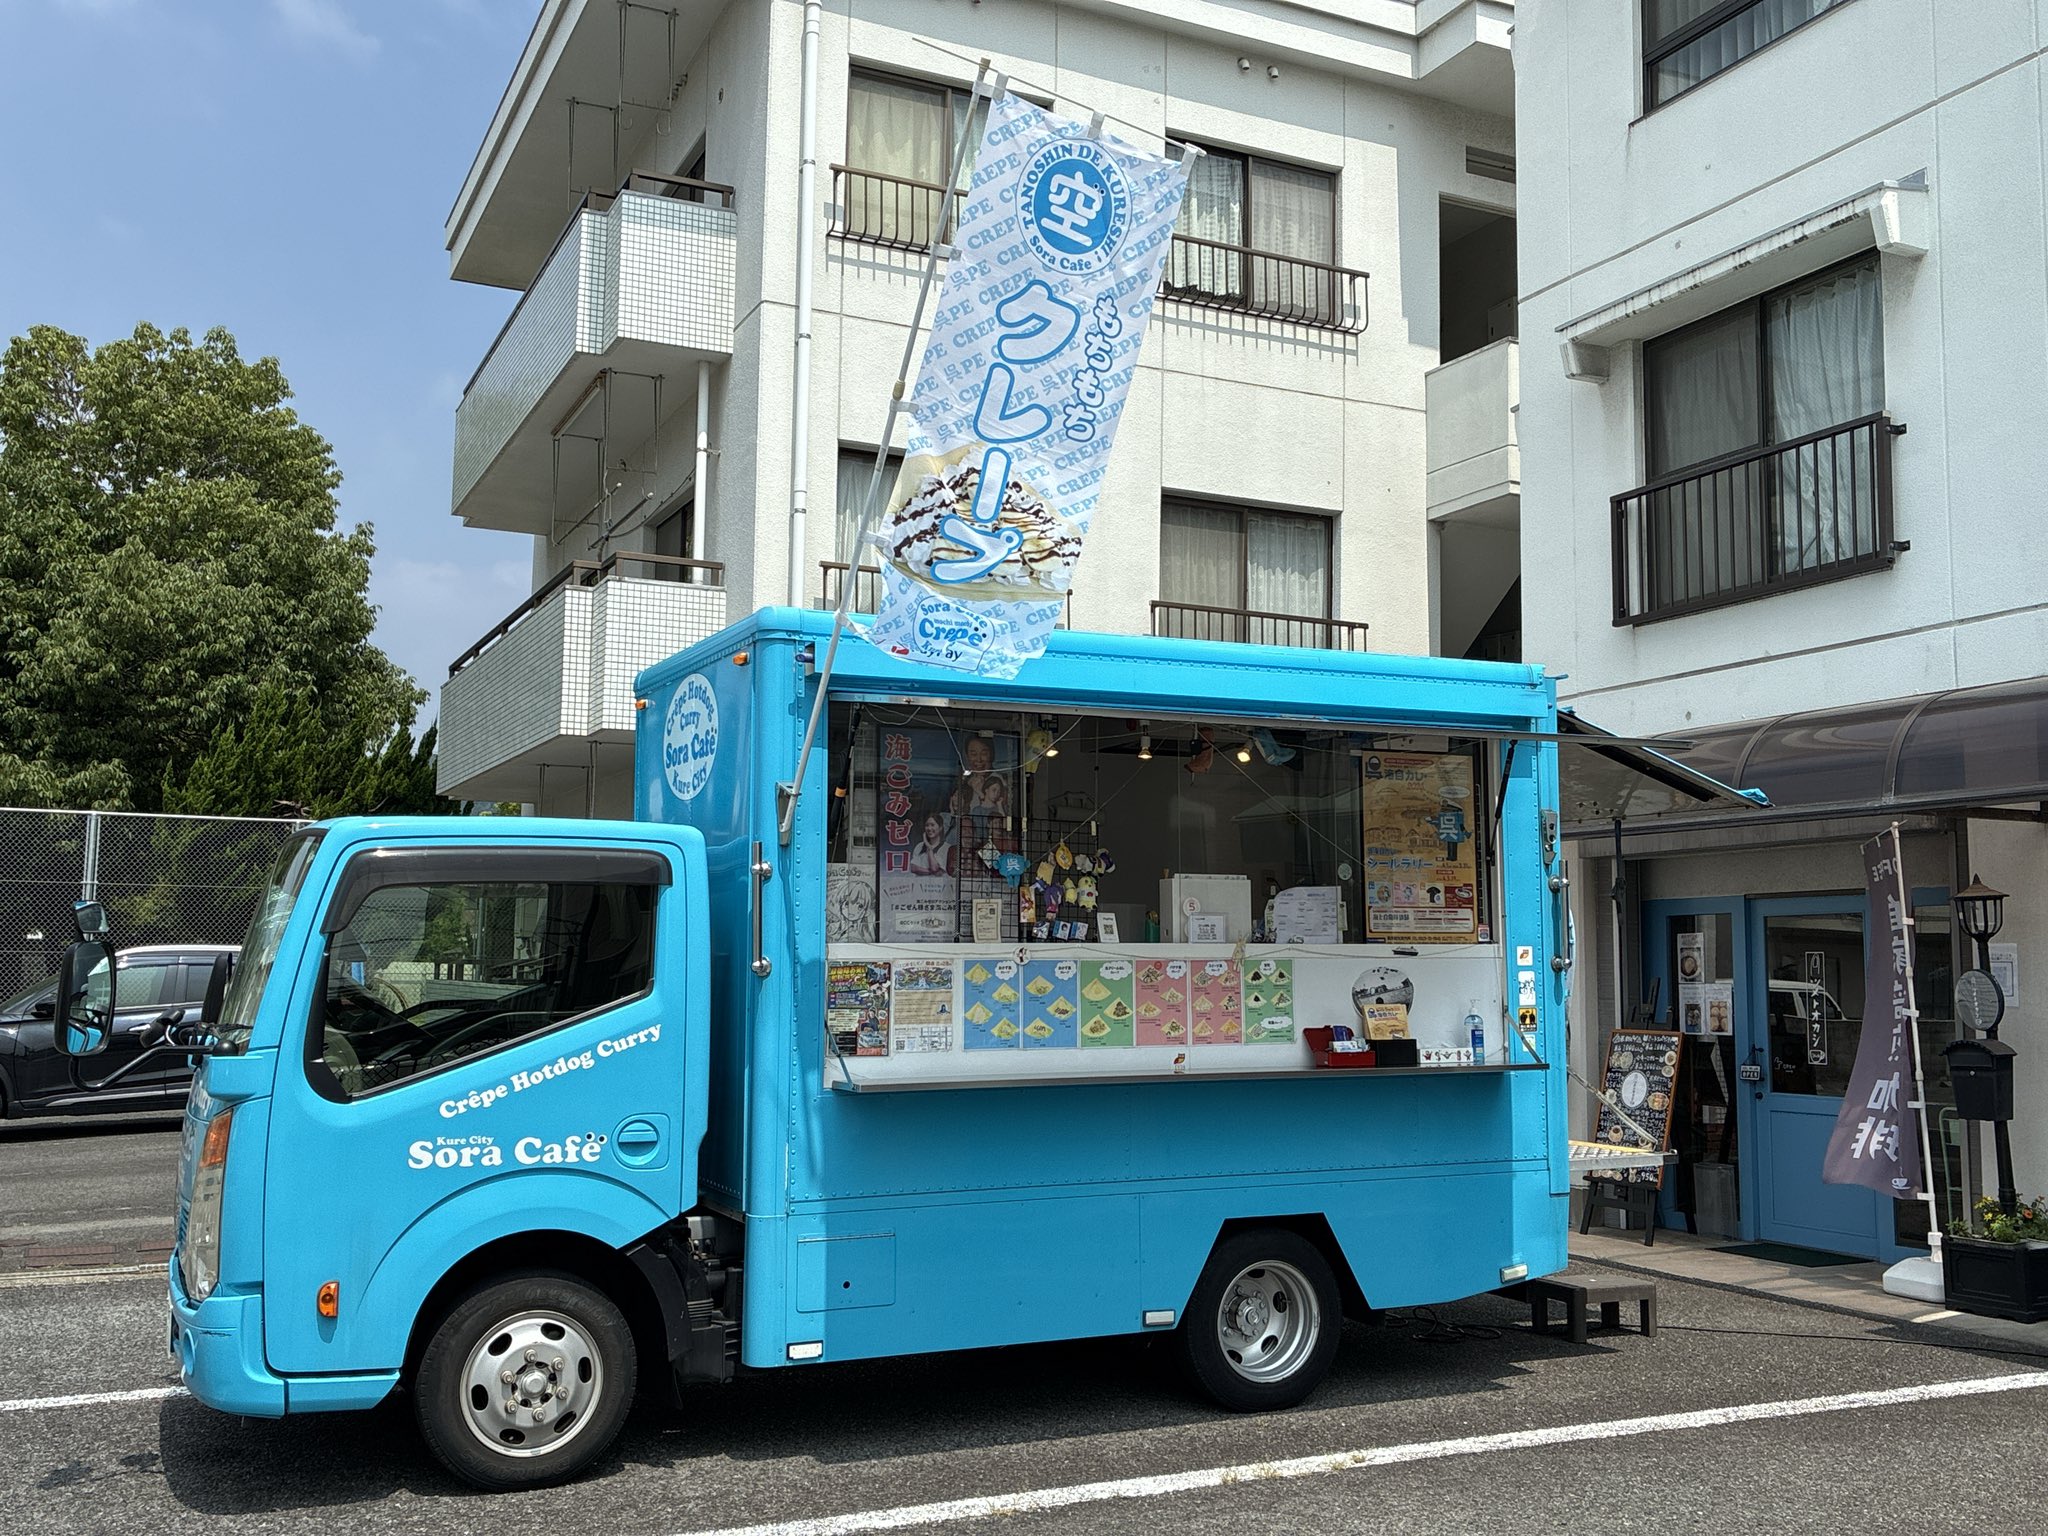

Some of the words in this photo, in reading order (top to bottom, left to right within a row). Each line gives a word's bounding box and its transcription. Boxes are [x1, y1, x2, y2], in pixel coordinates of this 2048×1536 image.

[986, 108, 1046, 147] CREPE
[970, 153, 1021, 191] REPE
[1021, 143, 1073, 230] TANOSHIN
[1077, 145, 1103, 167] DE
[959, 198, 994, 228] EPE
[967, 216, 1018, 250] CREP
[1122, 220, 1177, 261] CREP
[1030, 235, 1057, 266] Sora
[953, 316, 998, 347] CREP
[1063, 294, 1123, 443] もちもち
[1007, 385, 1039, 411] EPE
[930, 279, 1082, 584] クレープ
[1054, 435, 1112, 471] CREPE
[920, 602, 951, 616] Sora
[688, 680, 715, 723] Hotdog
[680, 712, 701, 731] Curry
[666, 742, 689, 769] Sora
[673, 769, 691, 794] Kure
[692, 762, 708, 791] City
[884, 734, 913, 873] 海ごみゼロ
[1439, 816, 1458, 840] 呉
[1006, 858, 1020, 872] 呉
[1367, 857, 1433, 871] シールラリー
[1188, 902, 1196, 912] 5
[439, 1085, 508, 1118] Crêpe
[510, 1051, 595, 1092] Hotdog
[597, 1024, 662, 1058] Curry
[1742, 1070, 1759, 1078] OPEN
[408, 1140, 503, 1169] Sora
[436, 1137, 467, 1146] Kure
[469, 1136, 495, 1146] City
